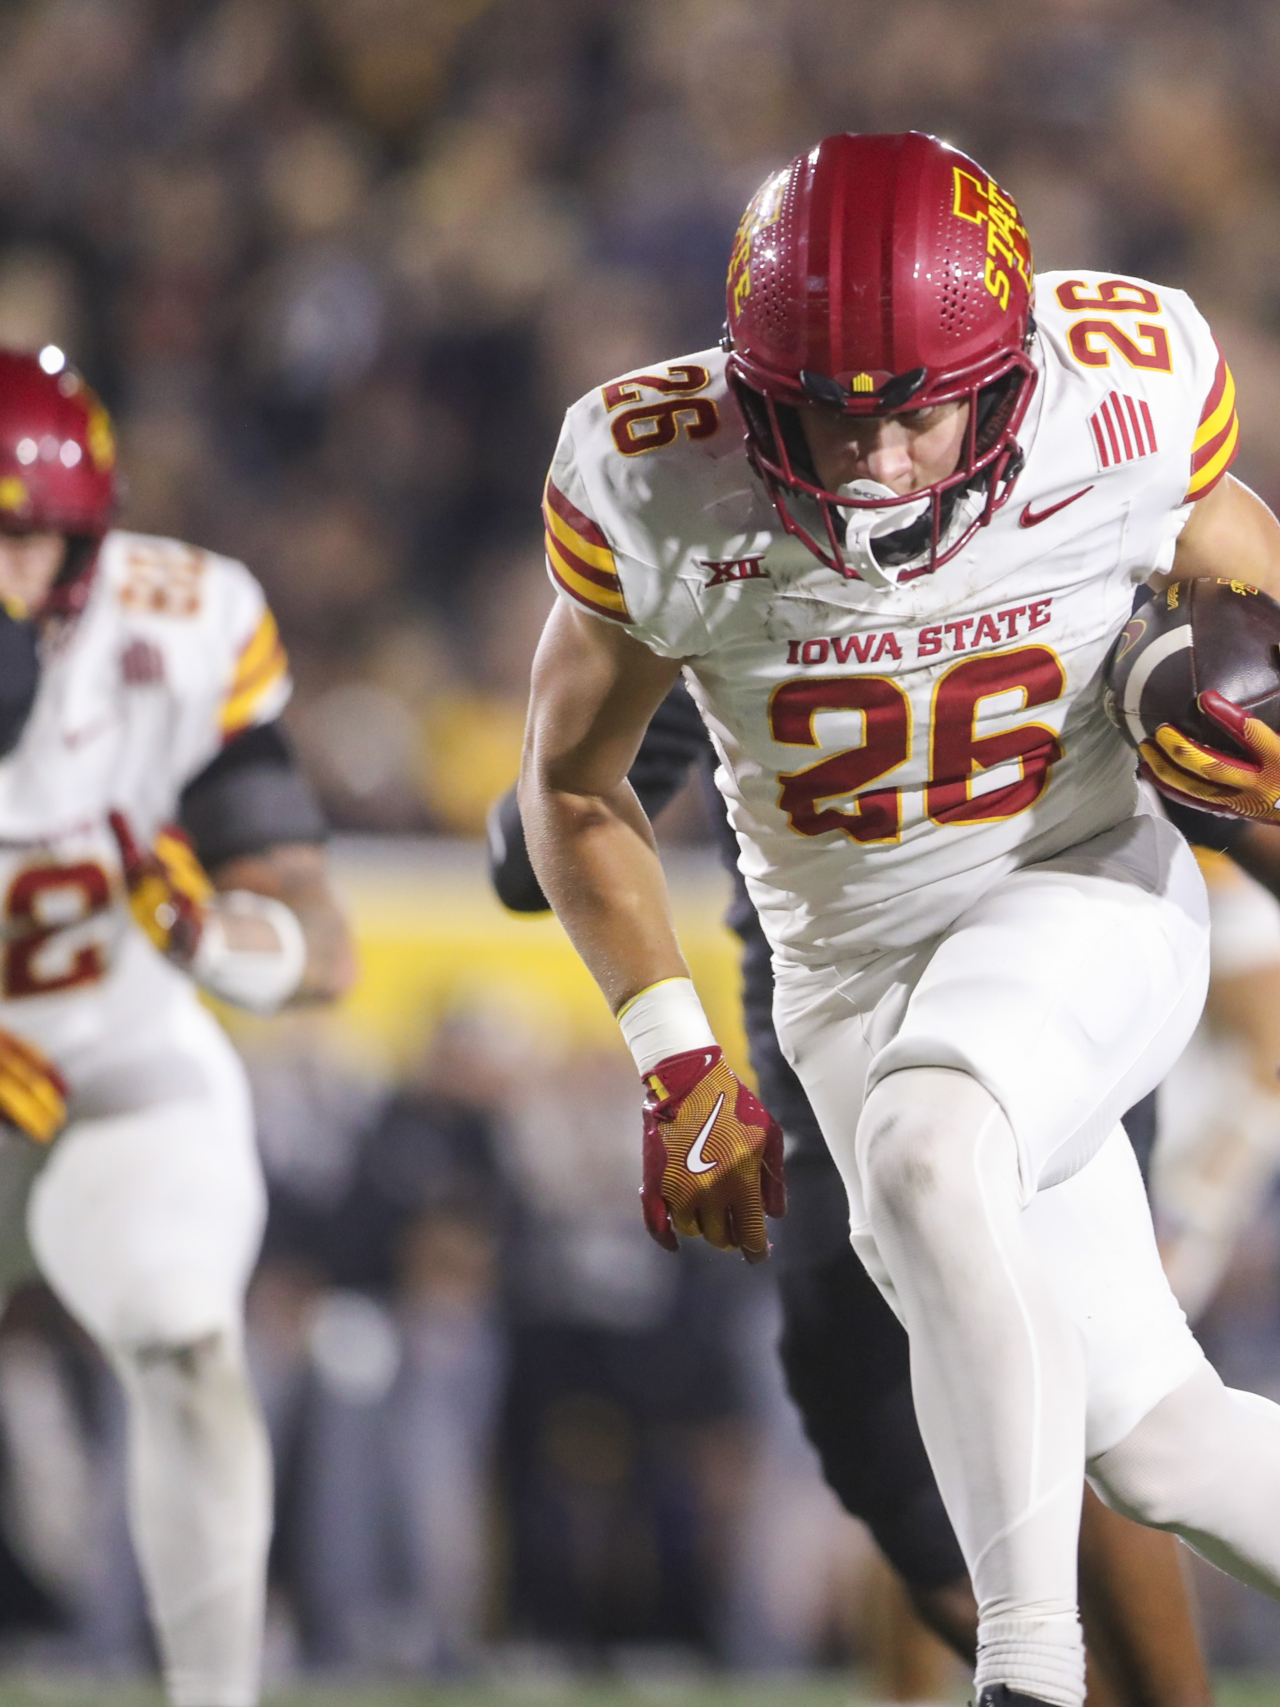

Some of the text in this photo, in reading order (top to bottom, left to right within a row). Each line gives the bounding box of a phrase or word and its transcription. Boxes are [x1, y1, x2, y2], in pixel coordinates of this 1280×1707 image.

[983, 177, 1018, 311] STAT
[1054, 279, 1174, 374] 26
[601, 365, 719, 458] 26
[700, 555, 770, 588] XII
[786, 597, 1053, 665] IOWA STATE
[767, 643, 1067, 845] 26
